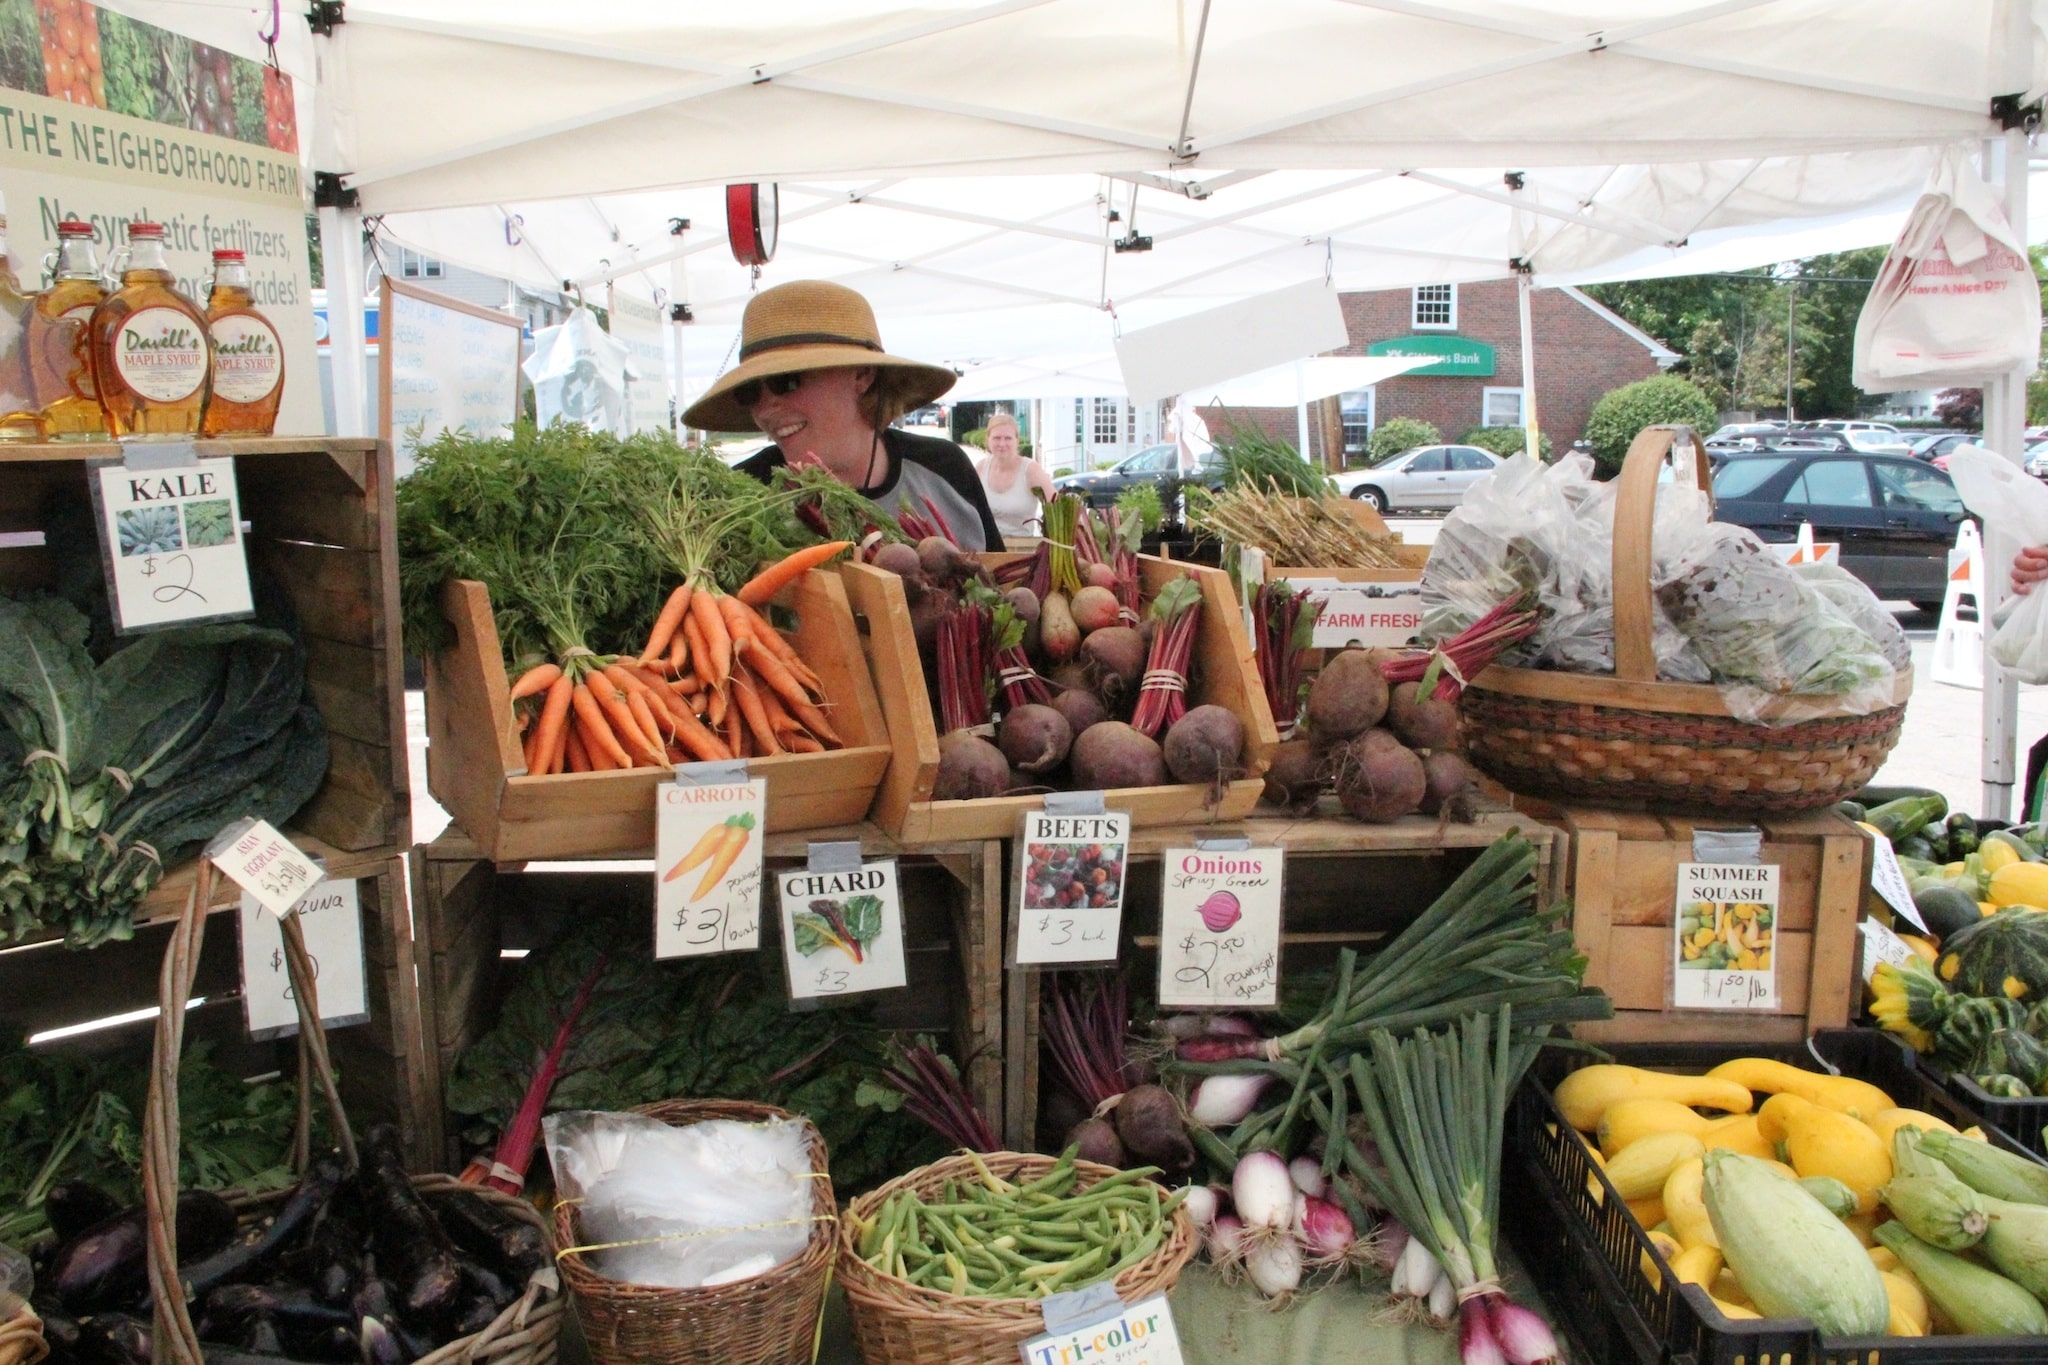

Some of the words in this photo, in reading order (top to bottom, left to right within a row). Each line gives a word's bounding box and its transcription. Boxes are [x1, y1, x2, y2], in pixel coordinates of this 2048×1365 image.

[0, 106, 62, 157] THE
[71, 120, 251, 188] NEIGHBORHOOD
[257, 160, 299, 197] FARM
[202, 214, 291, 263] fertilizers,
[1908, 284, 1938, 295] Have
[1942, 284, 1951, 294] A
[1953, 282, 1982, 294] Nice
[1984, 280, 2008, 291] Day
[124, 354, 164, 367] MAPLE
[168, 354, 201, 366] SYRUP
[215, 358, 242, 370] APLE
[245, 359, 276, 370] SYRUP
[1453, 353, 1480, 364] Bank
[128, 472, 217, 501] KALE
[1318, 613, 1365, 628] FARM
[666, 787, 757, 805] CARROTS
[1037, 818, 1119, 839] BEETS
[236, 834, 261, 857] ASIAN
[242, 840, 283, 878] EGGPLANT
[1182, 855, 1263, 874] Onions
[786, 870, 886, 897] CHARD
[1171, 873, 1216, 890] Spring
[1225, 875, 1270, 888] Green
[1689, 867, 1769, 882] SUMMER
[1692, 886, 1763, 902] SQUASH
[1036, 1314, 1158, 1365] Tri-color
